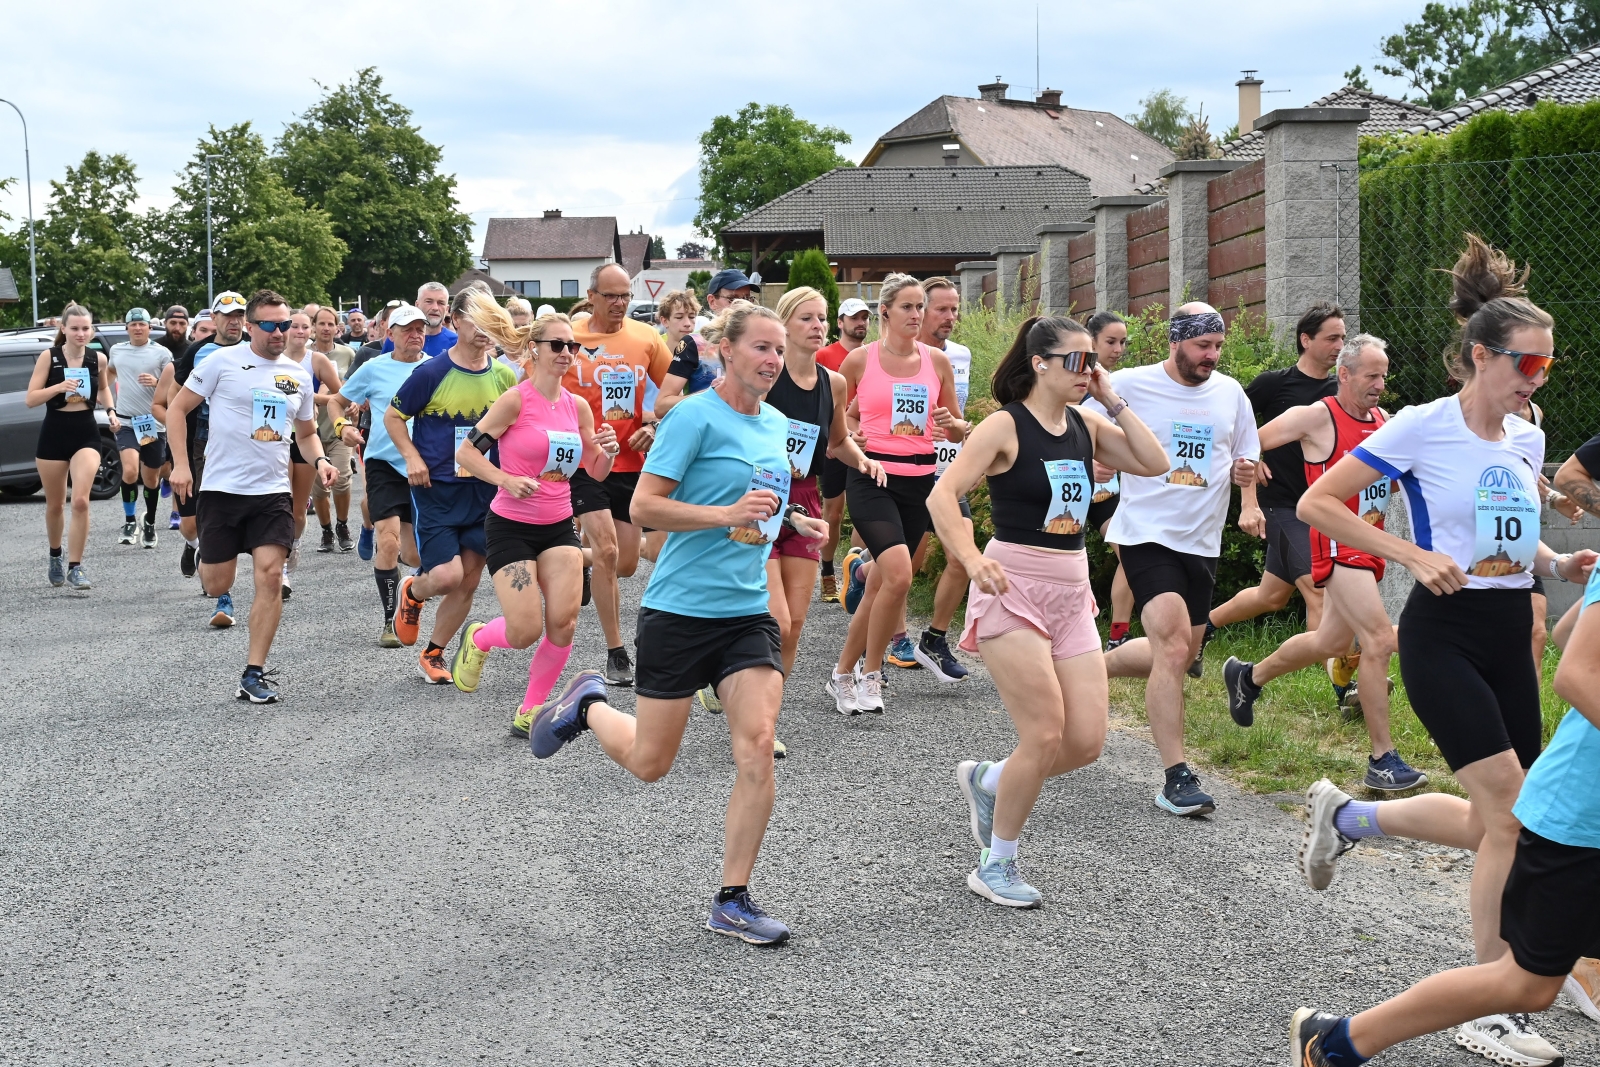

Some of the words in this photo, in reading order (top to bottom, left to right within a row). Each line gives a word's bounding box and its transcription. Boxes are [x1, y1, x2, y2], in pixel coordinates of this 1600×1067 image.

[605, 386, 632, 400] 207
[263, 404, 276, 420] 71
[896, 398, 925, 415] 236
[138, 423, 152, 433] 112
[555, 446, 575, 464] 94
[786, 437, 807, 455] 97
[934, 446, 957, 463] 08
[1176, 440, 1206, 460] 216
[1061, 482, 1082, 503] 82
[1364, 482, 1387, 501] 106
[1494, 515, 1522, 542] 10
[384, 578, 395, 611] Kalenji
